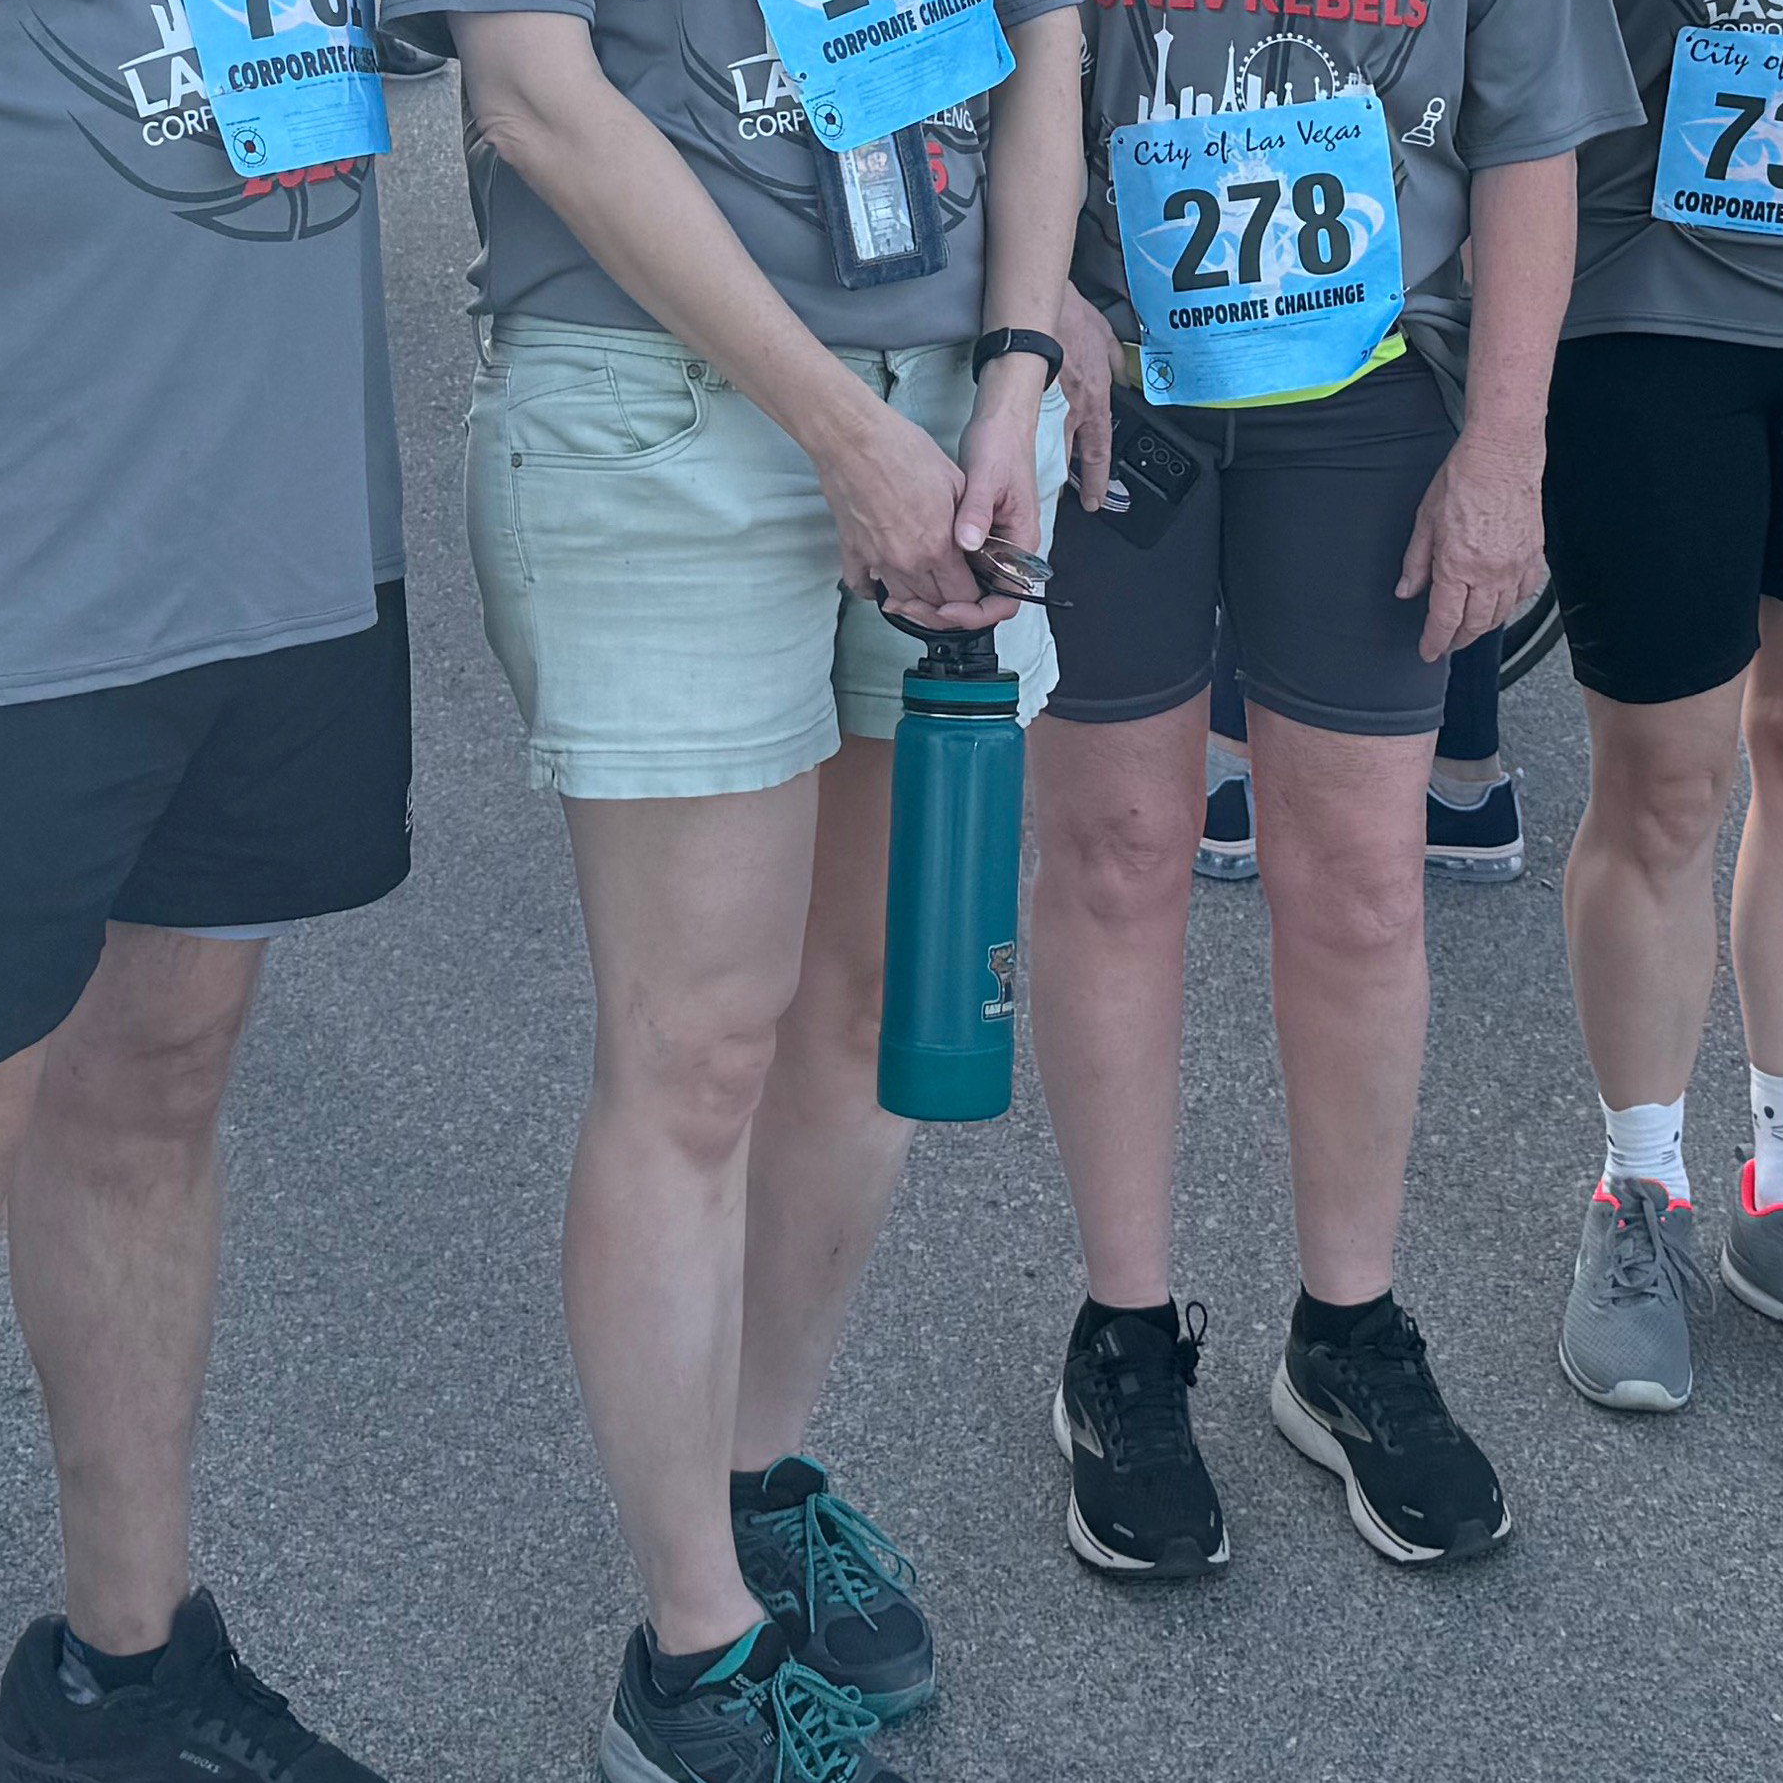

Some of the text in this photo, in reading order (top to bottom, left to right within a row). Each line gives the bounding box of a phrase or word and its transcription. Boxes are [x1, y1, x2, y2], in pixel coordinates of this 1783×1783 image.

[823, 9, 918, 63] CORPORATE
[1690, 39, 1749, 75] City
[228, 45, 347, 92] CORPORATE
[1135, 120, 1361, 169] City of Las Vegas
[1164, 172, 1352, 293] 278
[1169, 283, 1365, 329] CORPORATE CHALLENGE
